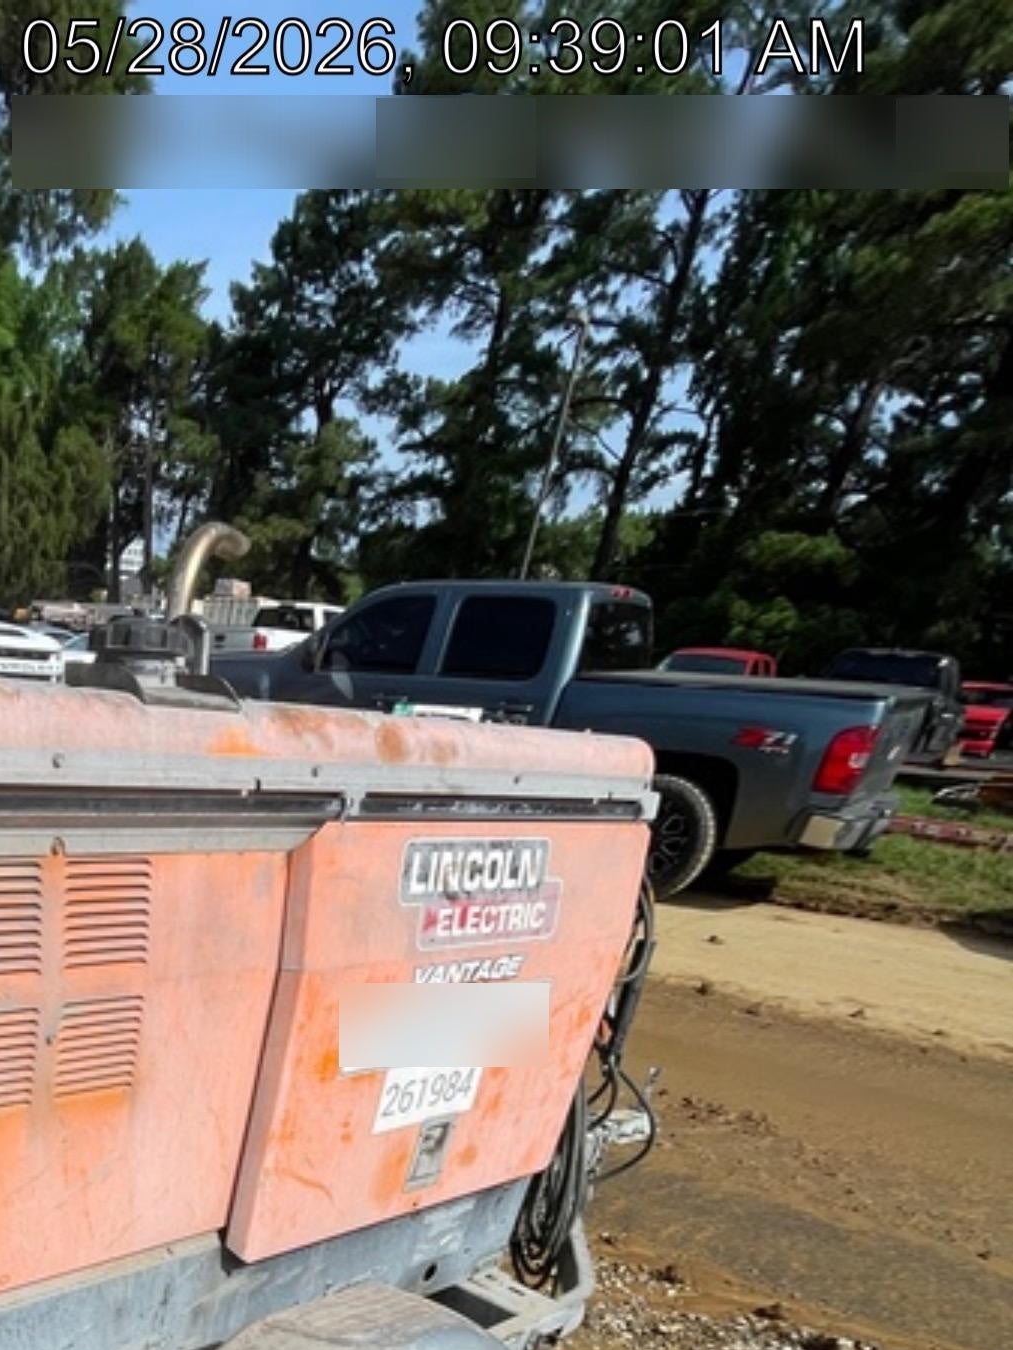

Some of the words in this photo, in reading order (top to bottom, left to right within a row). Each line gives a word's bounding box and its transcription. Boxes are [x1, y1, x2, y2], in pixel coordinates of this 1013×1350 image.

[408, 848, 543, 895] LINCOLN
[436, 902, 546, 937] ELECTRIC
[415, 954, 525, 983] VANTAGE
[381, 1067, 476, 1117] 261984
